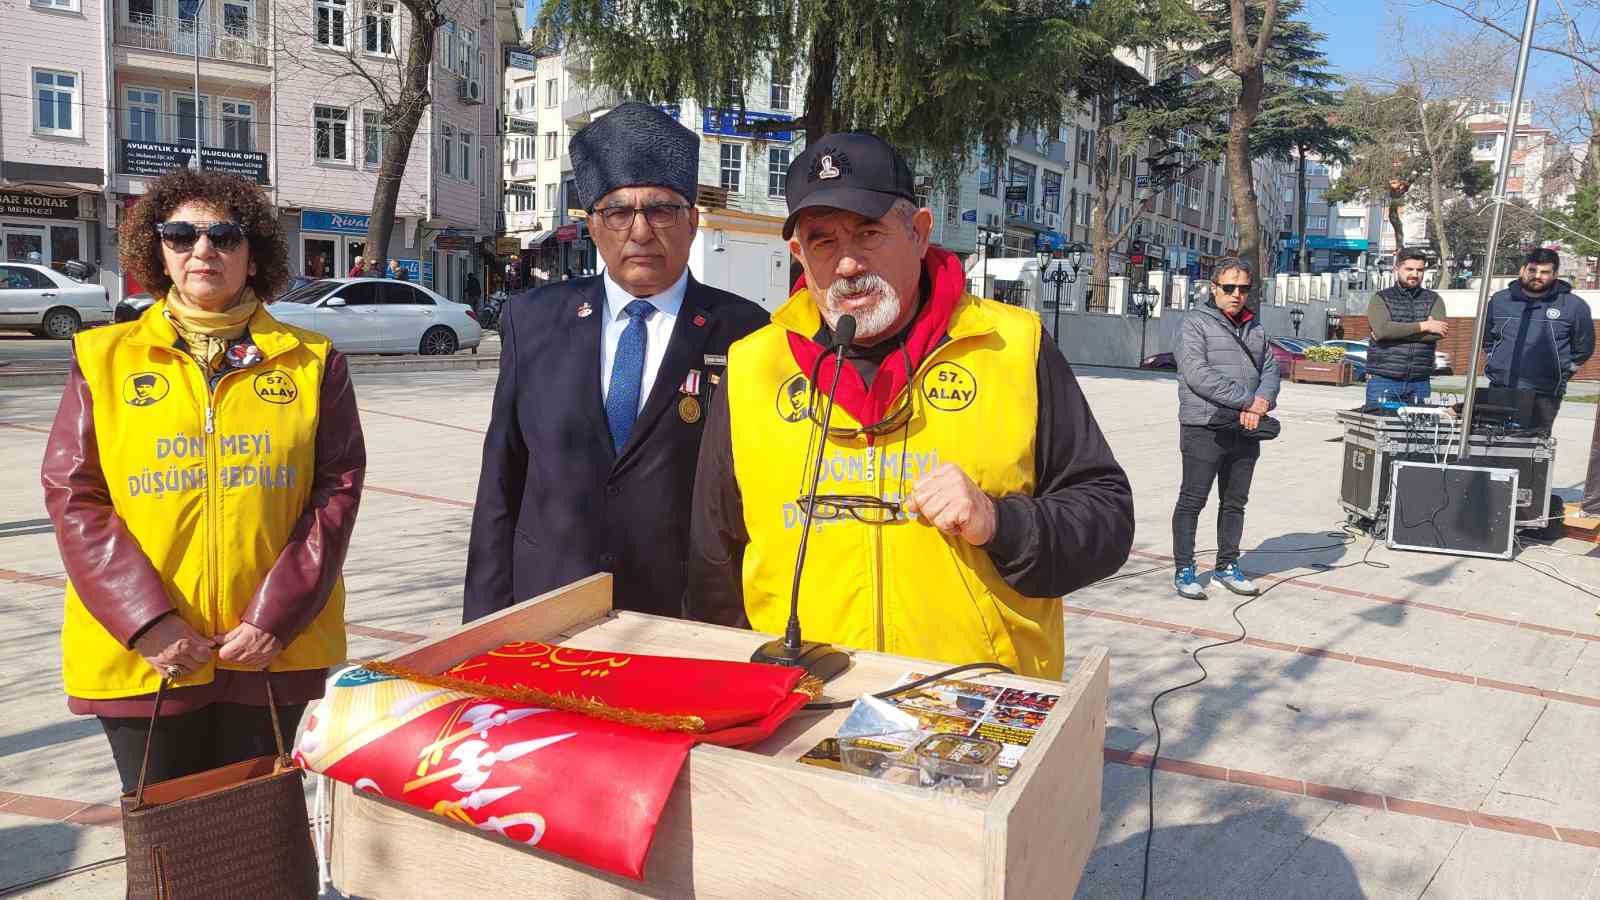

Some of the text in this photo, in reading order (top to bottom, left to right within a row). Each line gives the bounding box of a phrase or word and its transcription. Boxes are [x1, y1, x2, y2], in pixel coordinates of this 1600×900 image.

[127, 143, 171, 153] AVUKATLIK
[0, 194, 69, 208] AR KONAK
[938, 370, 963, 384] 57.
[261, 387, 295, 398] ALAY
[928, 387, 972, 402] ALAY
